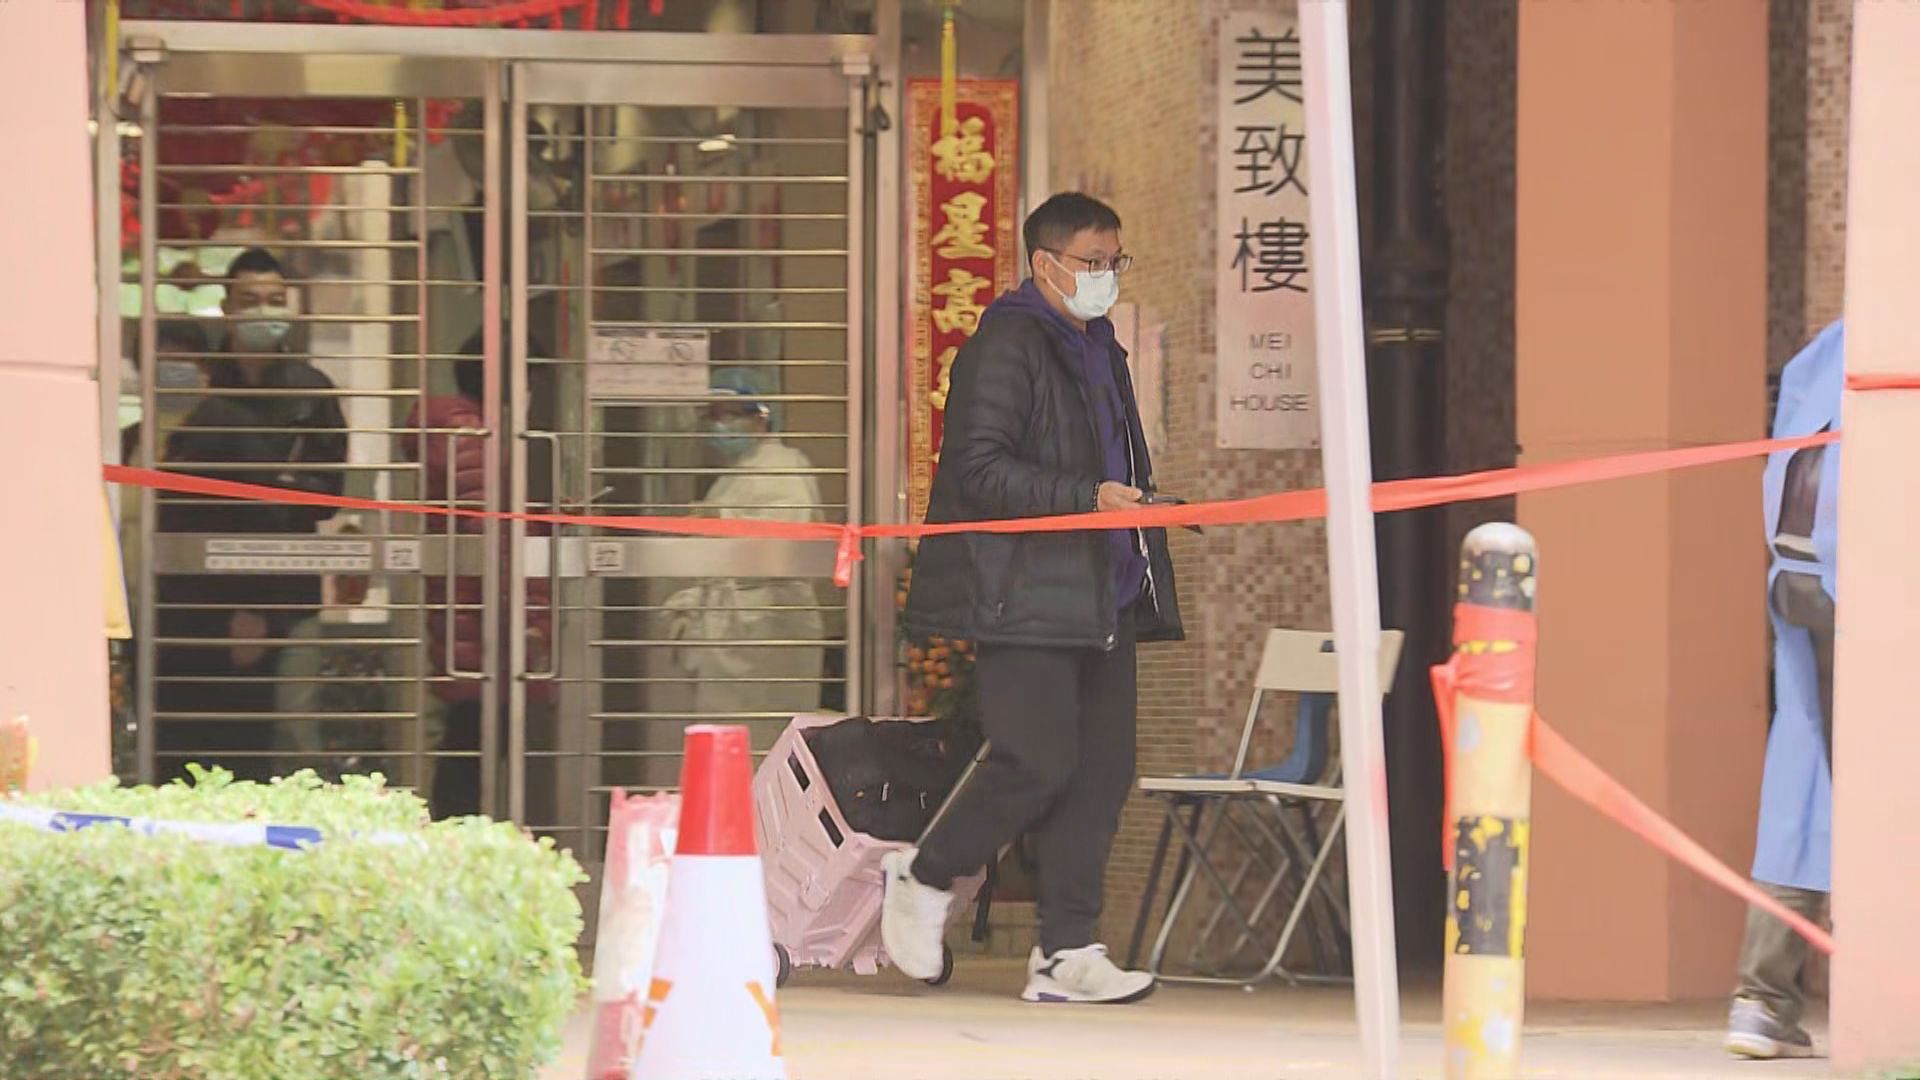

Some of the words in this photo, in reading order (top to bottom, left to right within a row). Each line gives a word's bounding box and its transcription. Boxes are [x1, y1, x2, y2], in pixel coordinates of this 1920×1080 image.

[1232, 27, 1310, 293] 美致樓
[930, 116, 995, 464] 福星高
[1249, 332, 1292, 351] MEI
[1249, 362, 1292, 380] CHI
[1230, 394, 1309, 412] HOUSE
